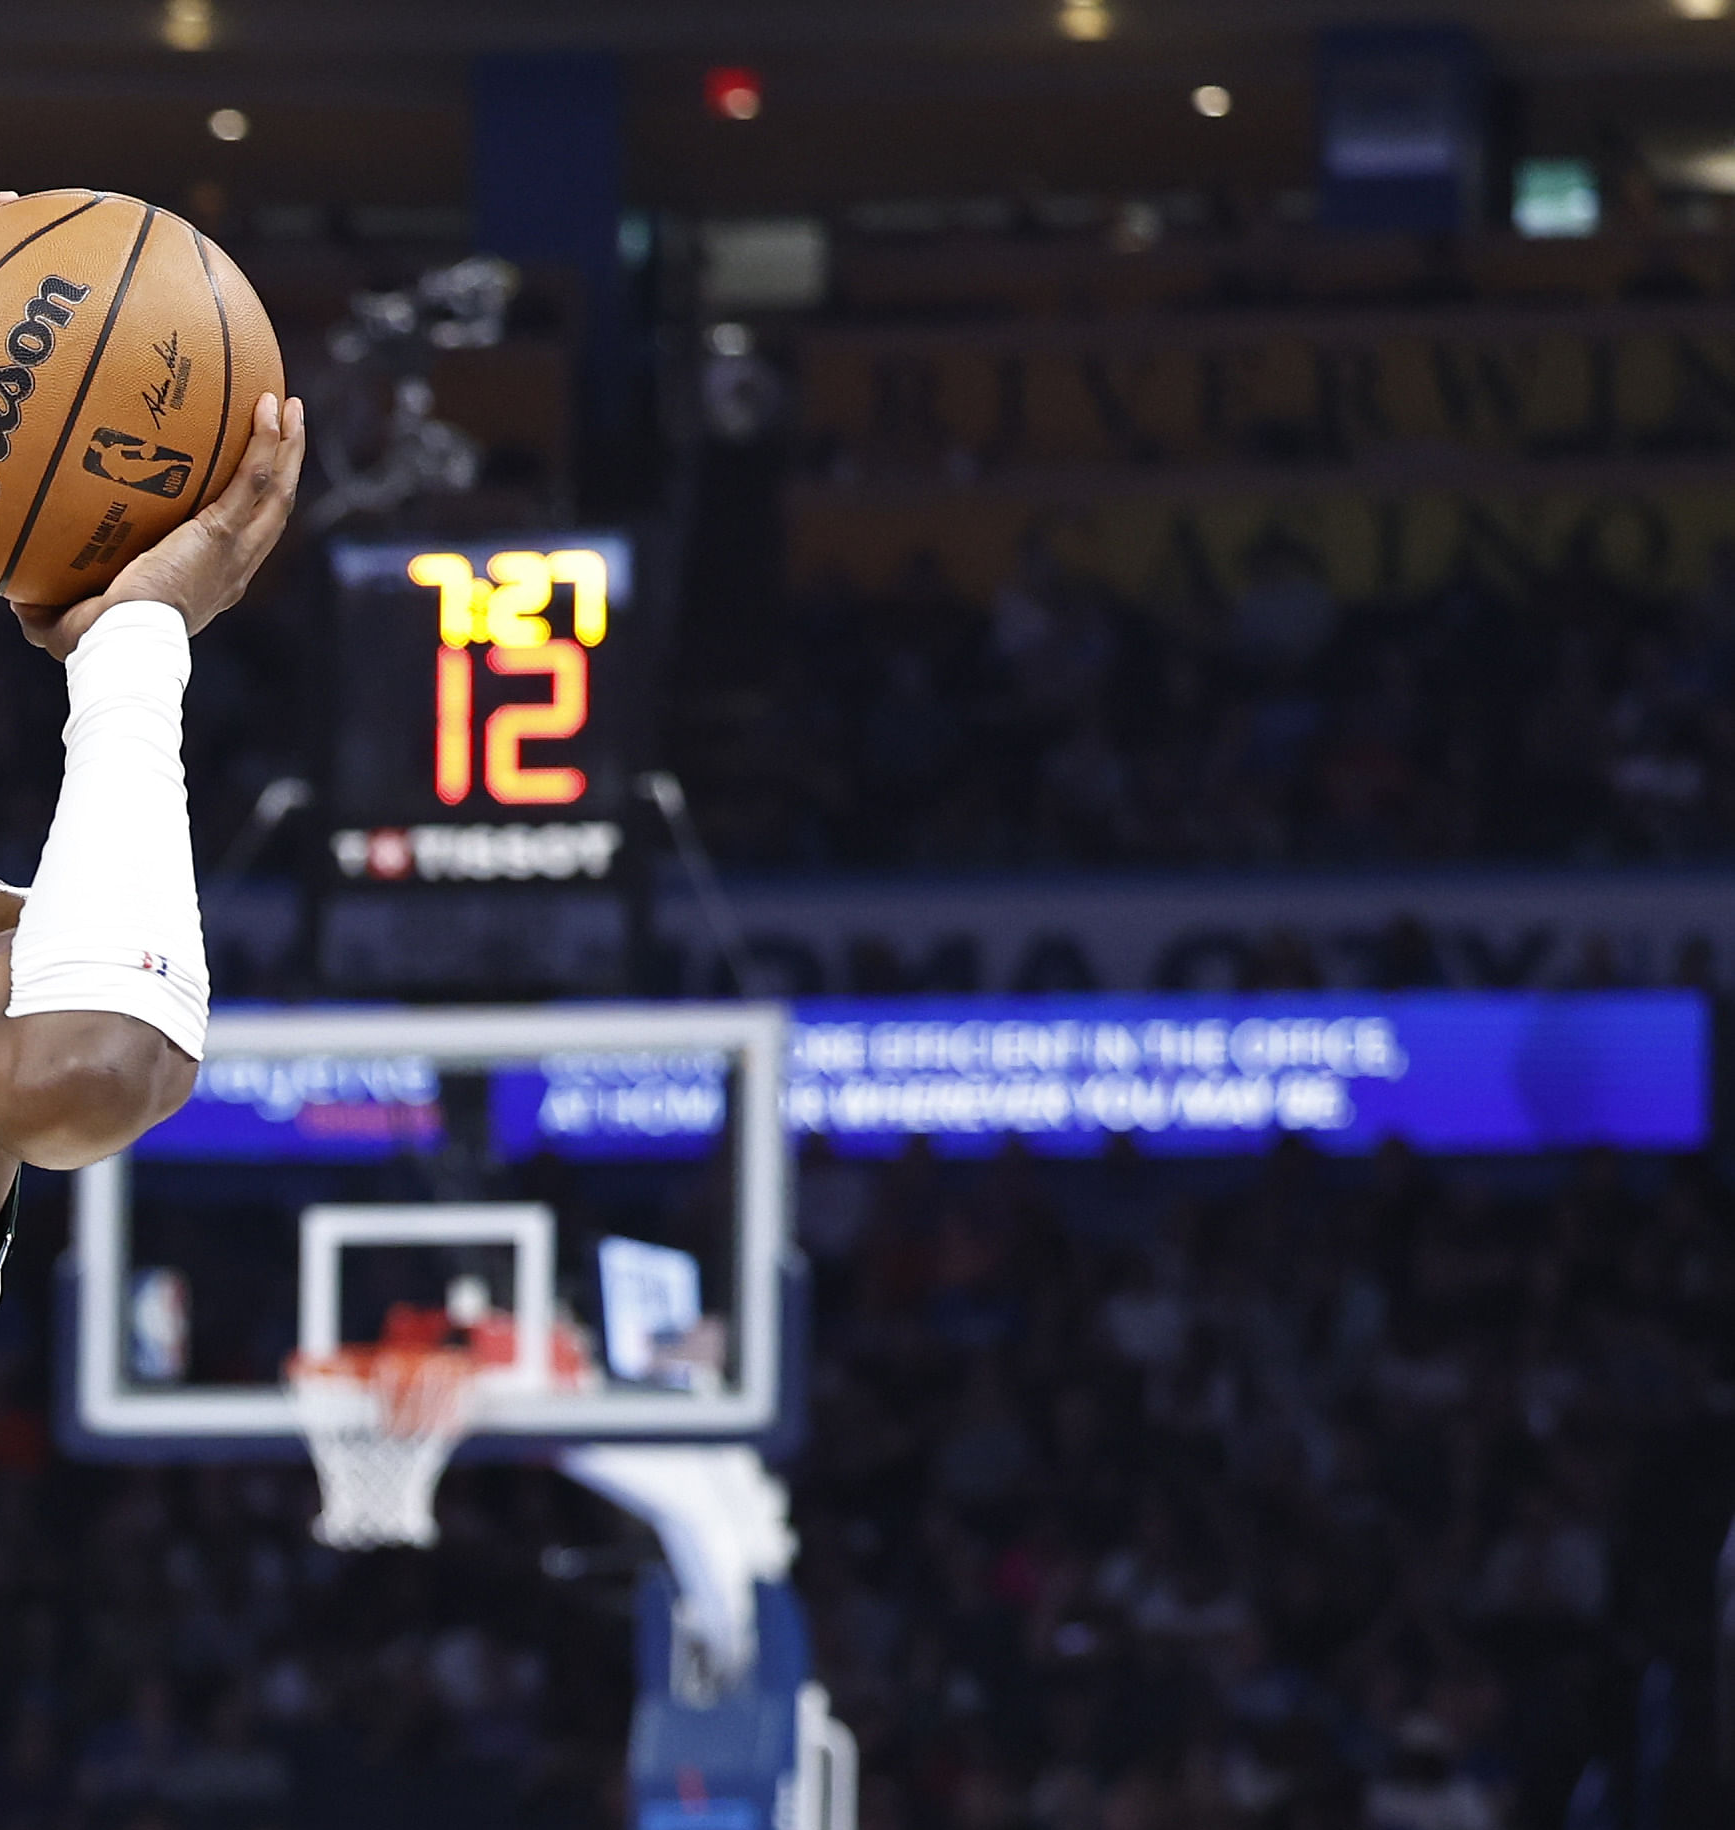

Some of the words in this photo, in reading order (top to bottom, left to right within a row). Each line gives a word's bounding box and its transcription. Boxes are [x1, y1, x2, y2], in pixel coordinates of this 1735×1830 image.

[104, 498, 129, 524] BALL
[407, 549, 608, 648] 7:27
[432, 638, 589, 806] 12
[412, 821, 623, 883] TISSOT
